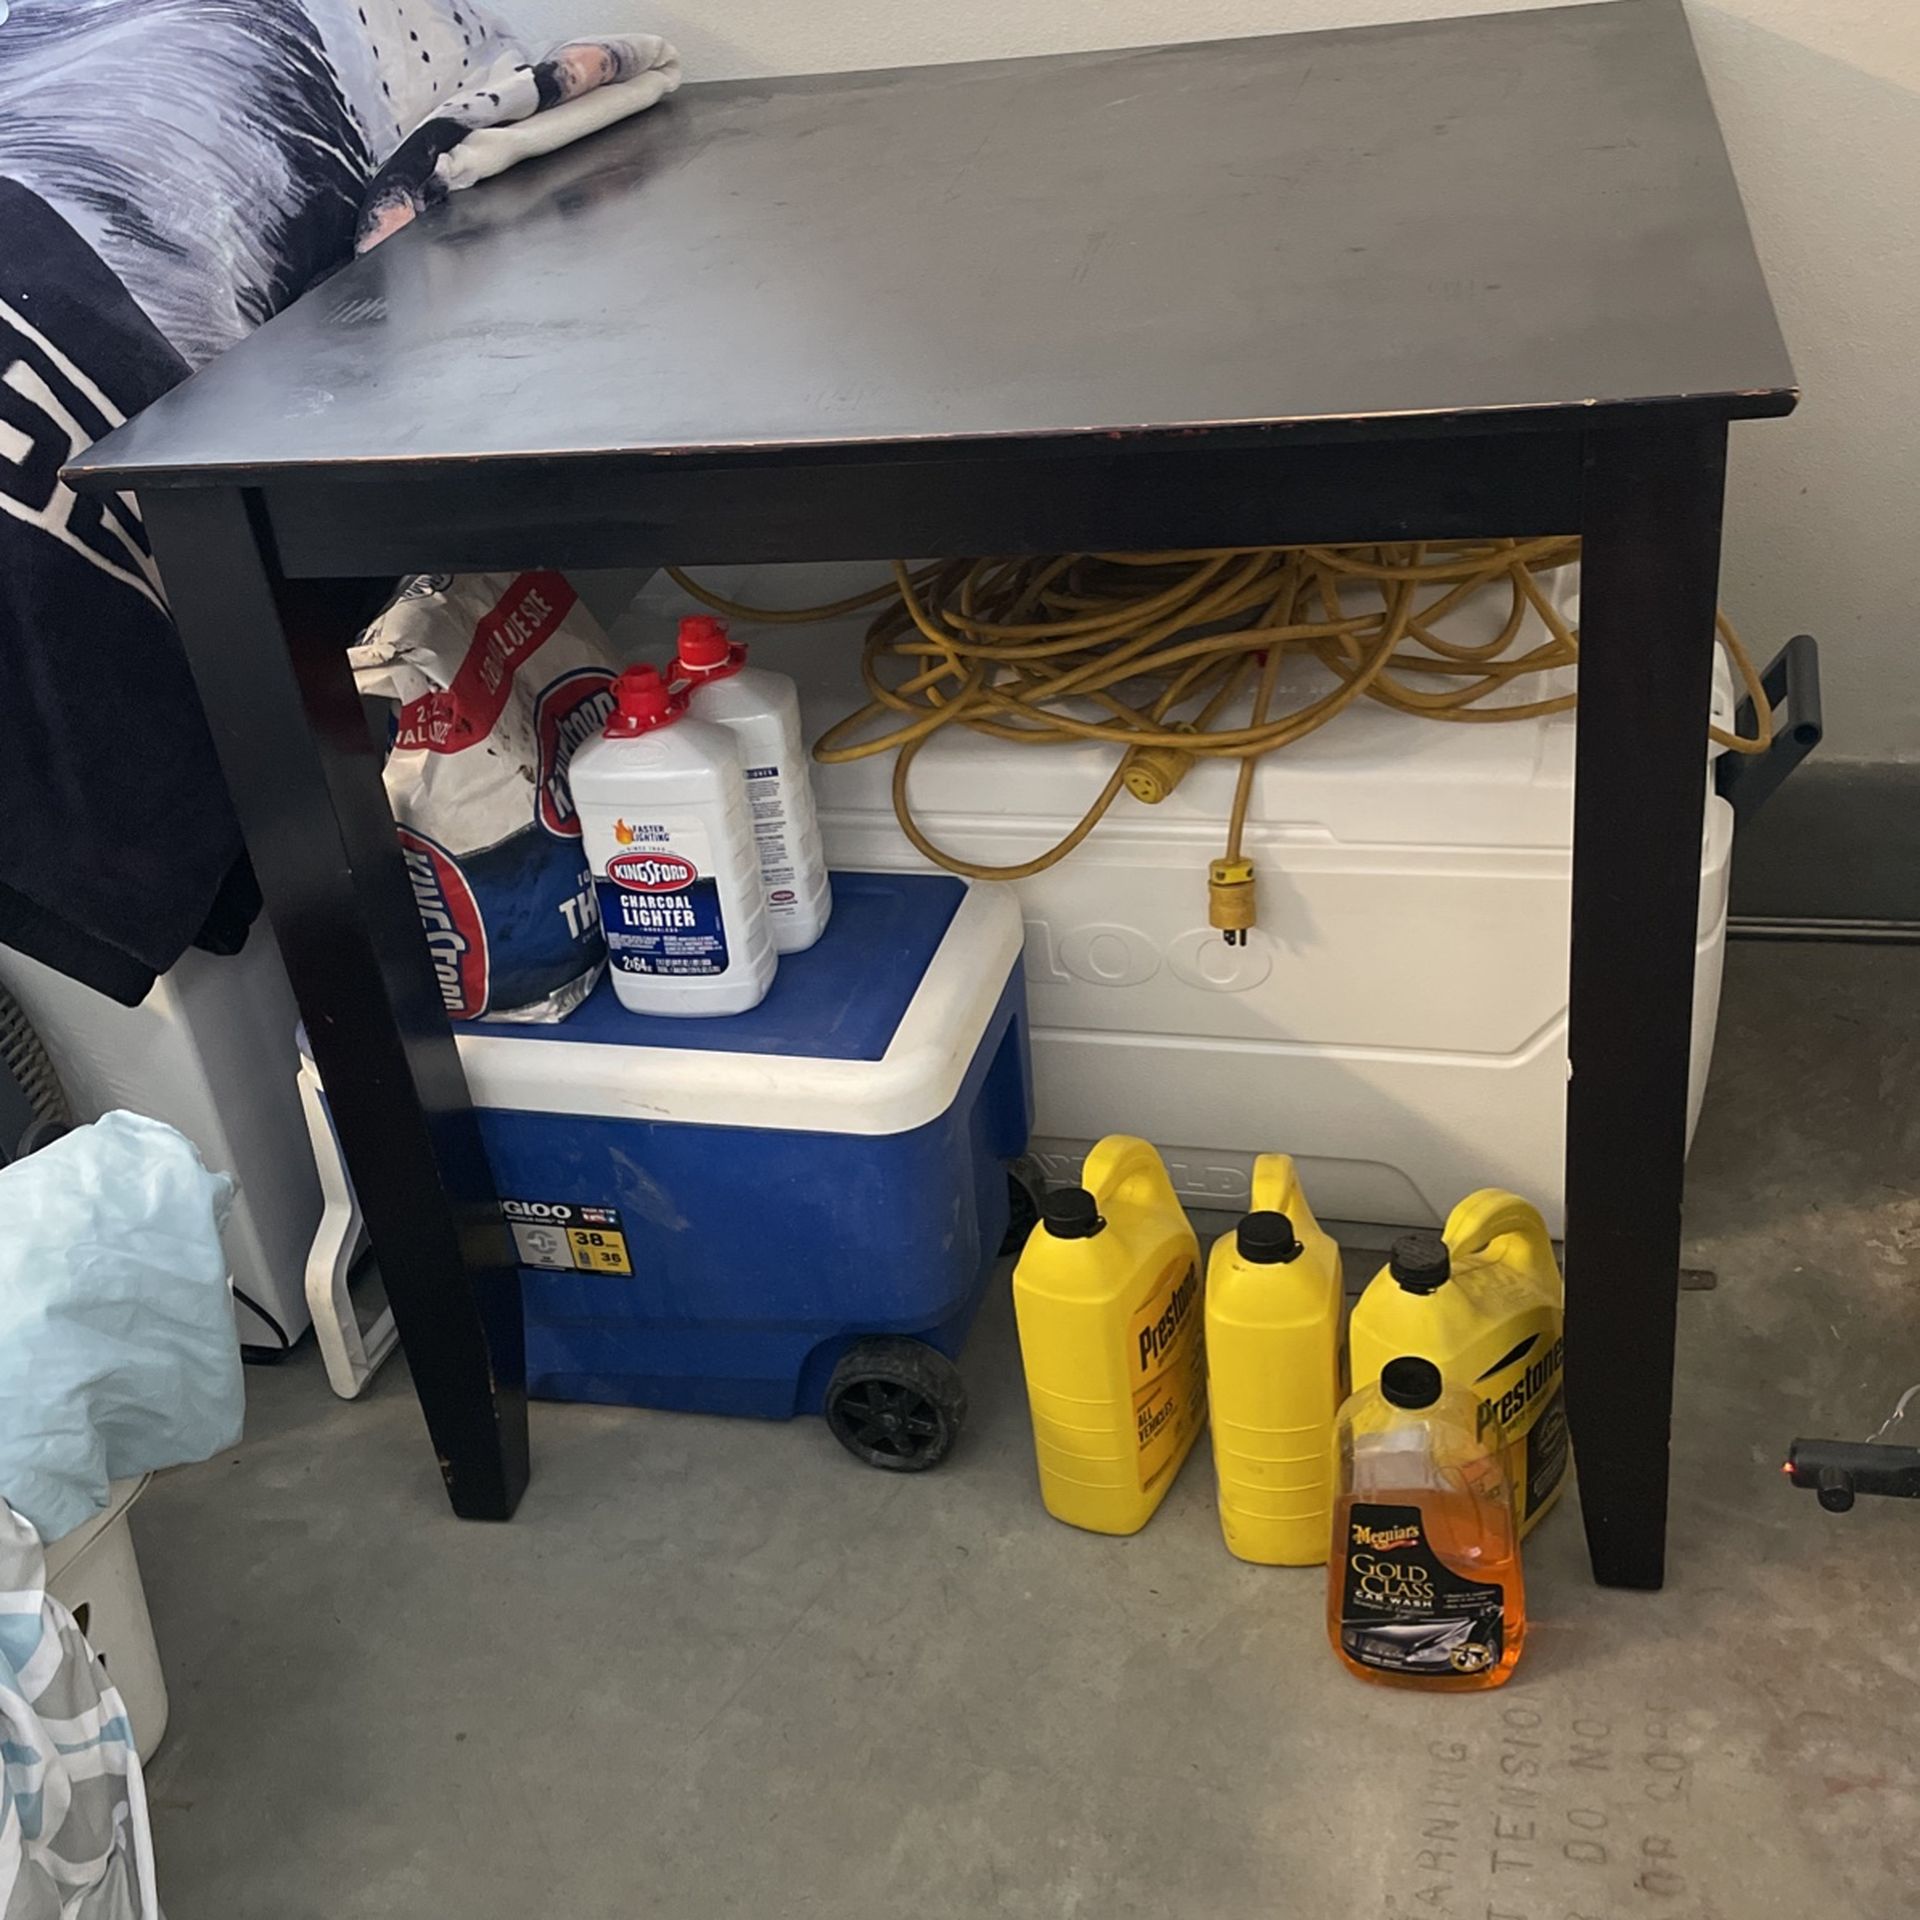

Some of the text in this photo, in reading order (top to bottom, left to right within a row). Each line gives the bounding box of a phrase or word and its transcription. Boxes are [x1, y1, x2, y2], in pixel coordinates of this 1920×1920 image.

[614, 860, 688, 886] KINGSFORD
[620, 895, 692, 909] CHARCOAL
[622, 909, 696, 928] LIGHTER
[500, 1201, 572, 1219] GLOO
[574, 1232, 604, 1247] 38
[601, 1252, 622, 1263] 36
[1138, 1407, 1153, 1427] ALL
[1351, 1553, 1428, 1584] GOLD
[1361, 1576, 1435, 1599] CLASS
[1355, 1591, 1384, 1602] CAR
[1389, 1598, 1433, 1608] WASH
[1415, 1740, 1467, 1920] ARNING
[1563, 1808, 1608, 1865] DO
